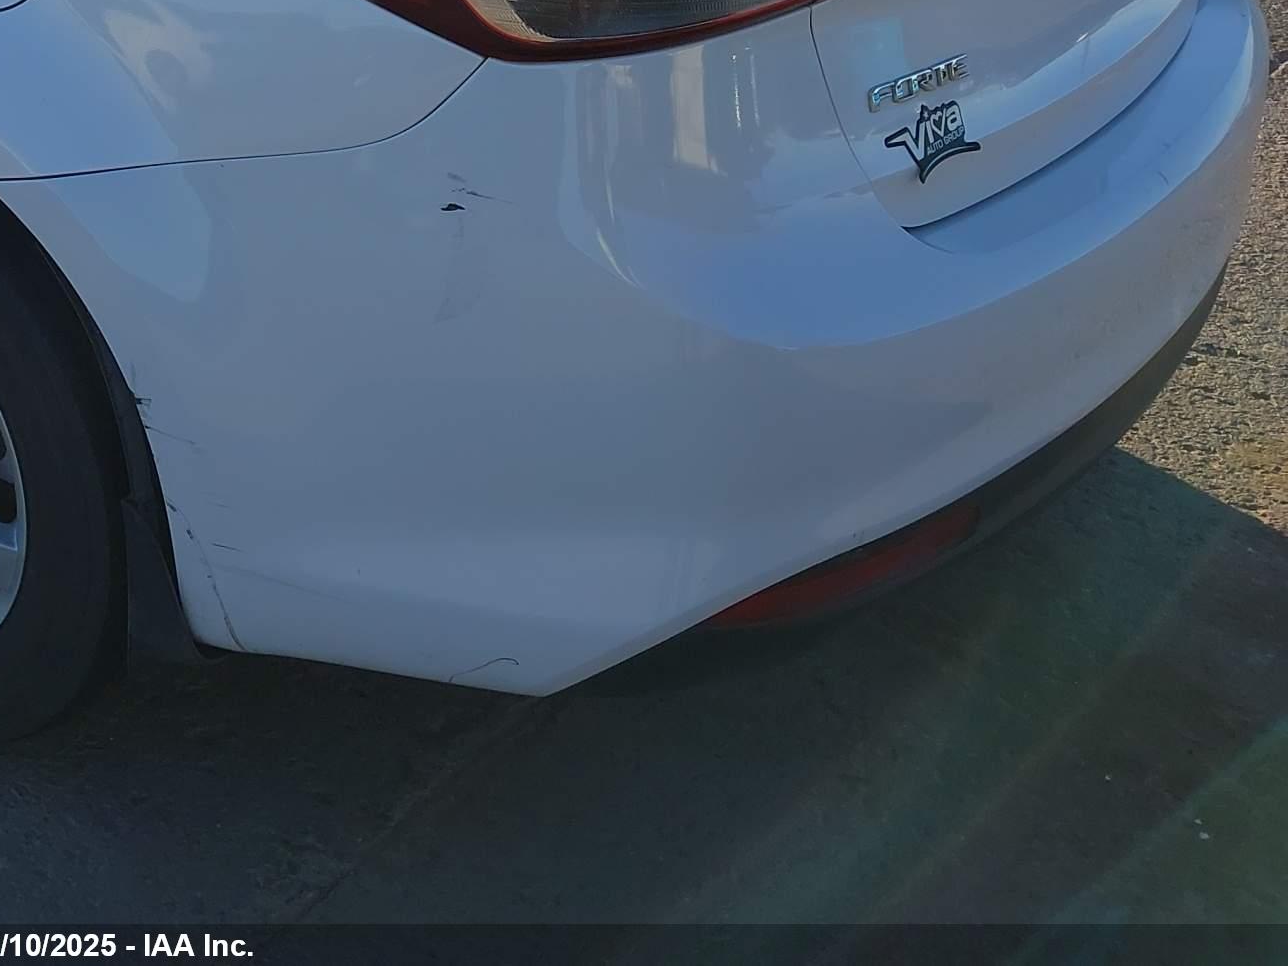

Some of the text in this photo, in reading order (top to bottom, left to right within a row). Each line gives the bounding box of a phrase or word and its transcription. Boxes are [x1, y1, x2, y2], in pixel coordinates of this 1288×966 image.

[867, 53, 970, 113] FORTE
[926, 126, 965, 155] AUTO GROUP
